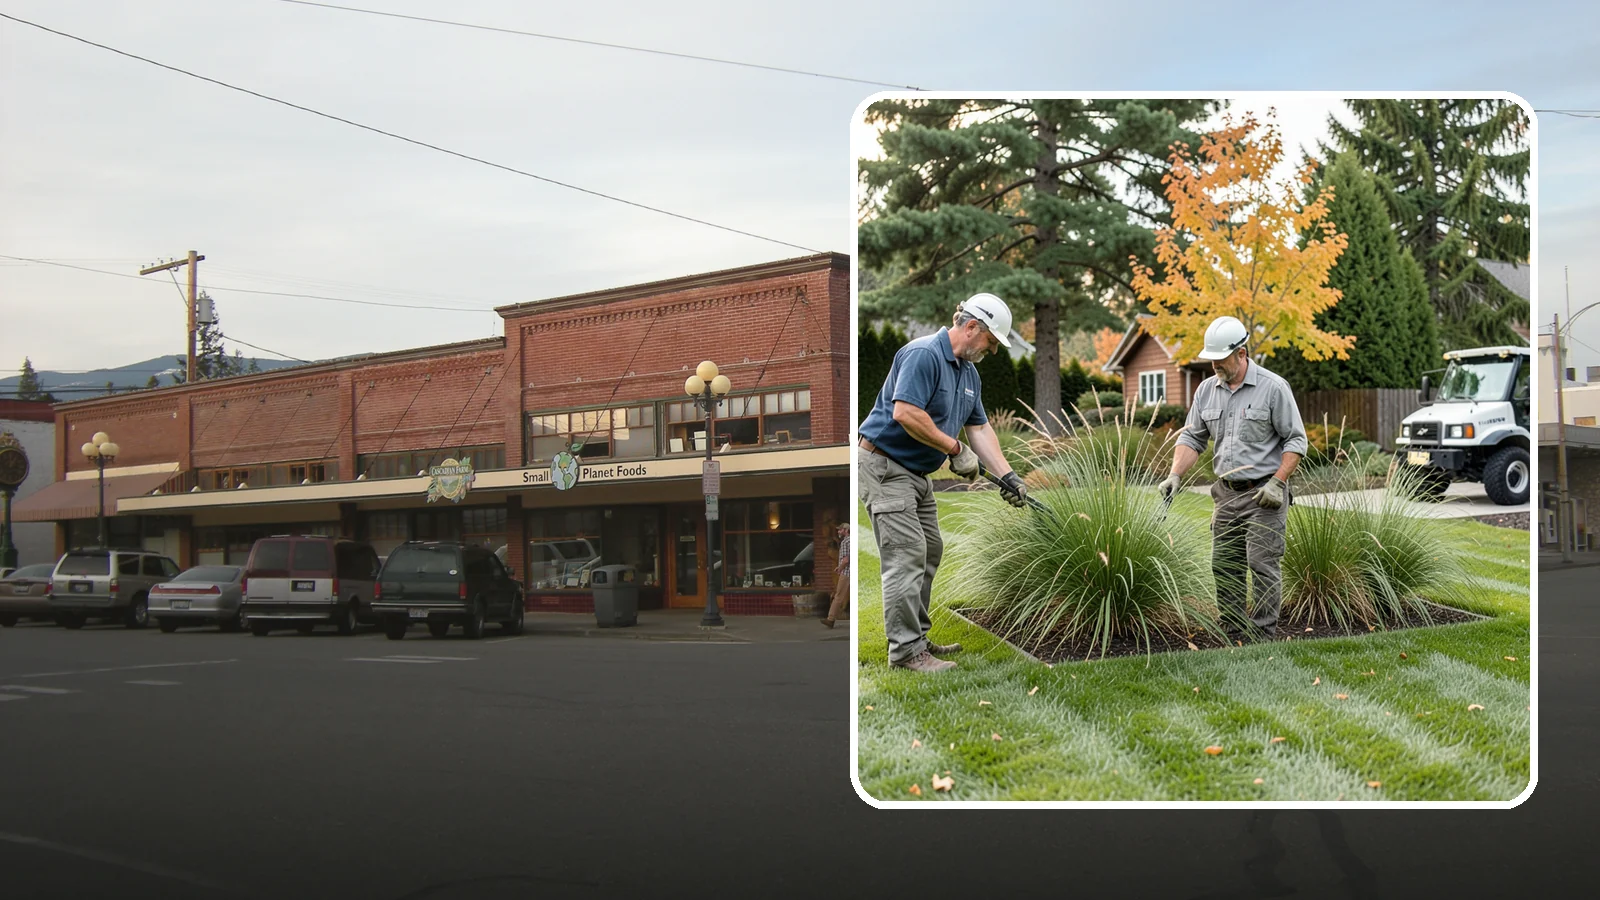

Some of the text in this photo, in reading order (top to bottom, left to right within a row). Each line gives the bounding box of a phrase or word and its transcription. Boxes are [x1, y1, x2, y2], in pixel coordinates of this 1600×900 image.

[431, 466, 469, 476] CASCADIAN FARM
[523, 464, 647, 483] Small Planet Foods
